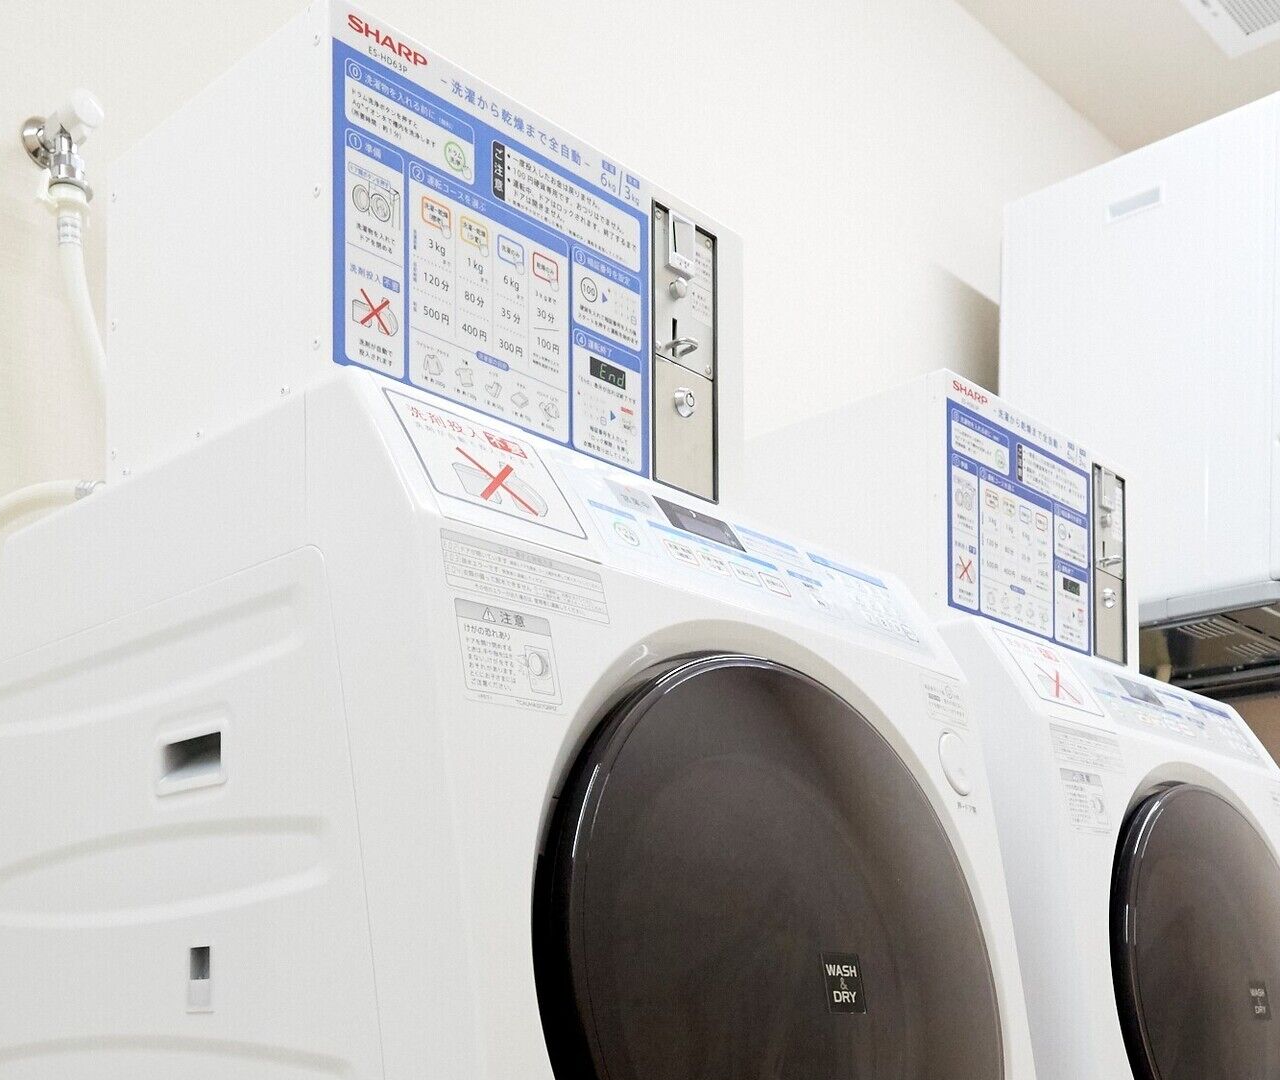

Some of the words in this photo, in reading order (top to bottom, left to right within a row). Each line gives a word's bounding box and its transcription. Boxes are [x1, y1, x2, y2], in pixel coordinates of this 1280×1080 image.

[348, 14, 427, 66] SHARP
[423, 272, 449, 292] 120分
[464, 291, 484, 308] 80分
[423, 305, 449, 326] 500円
[501, 308, 520, 325] 35分
[537, 307, 555, 324] 30分
[462, 323, 487, 343] 400円
[499, 338, 523, 358] 300円
[537, 336, 560, 355] 100円
[599, 362, 625, 388] End
[952, 380, 988, 405] SHARP
[500, 610, 525, 628] 注意
[825, 964, 857, 977] WASH
[840, 977, 849, 990] &
[833, 990, 856, 1003] DRY
